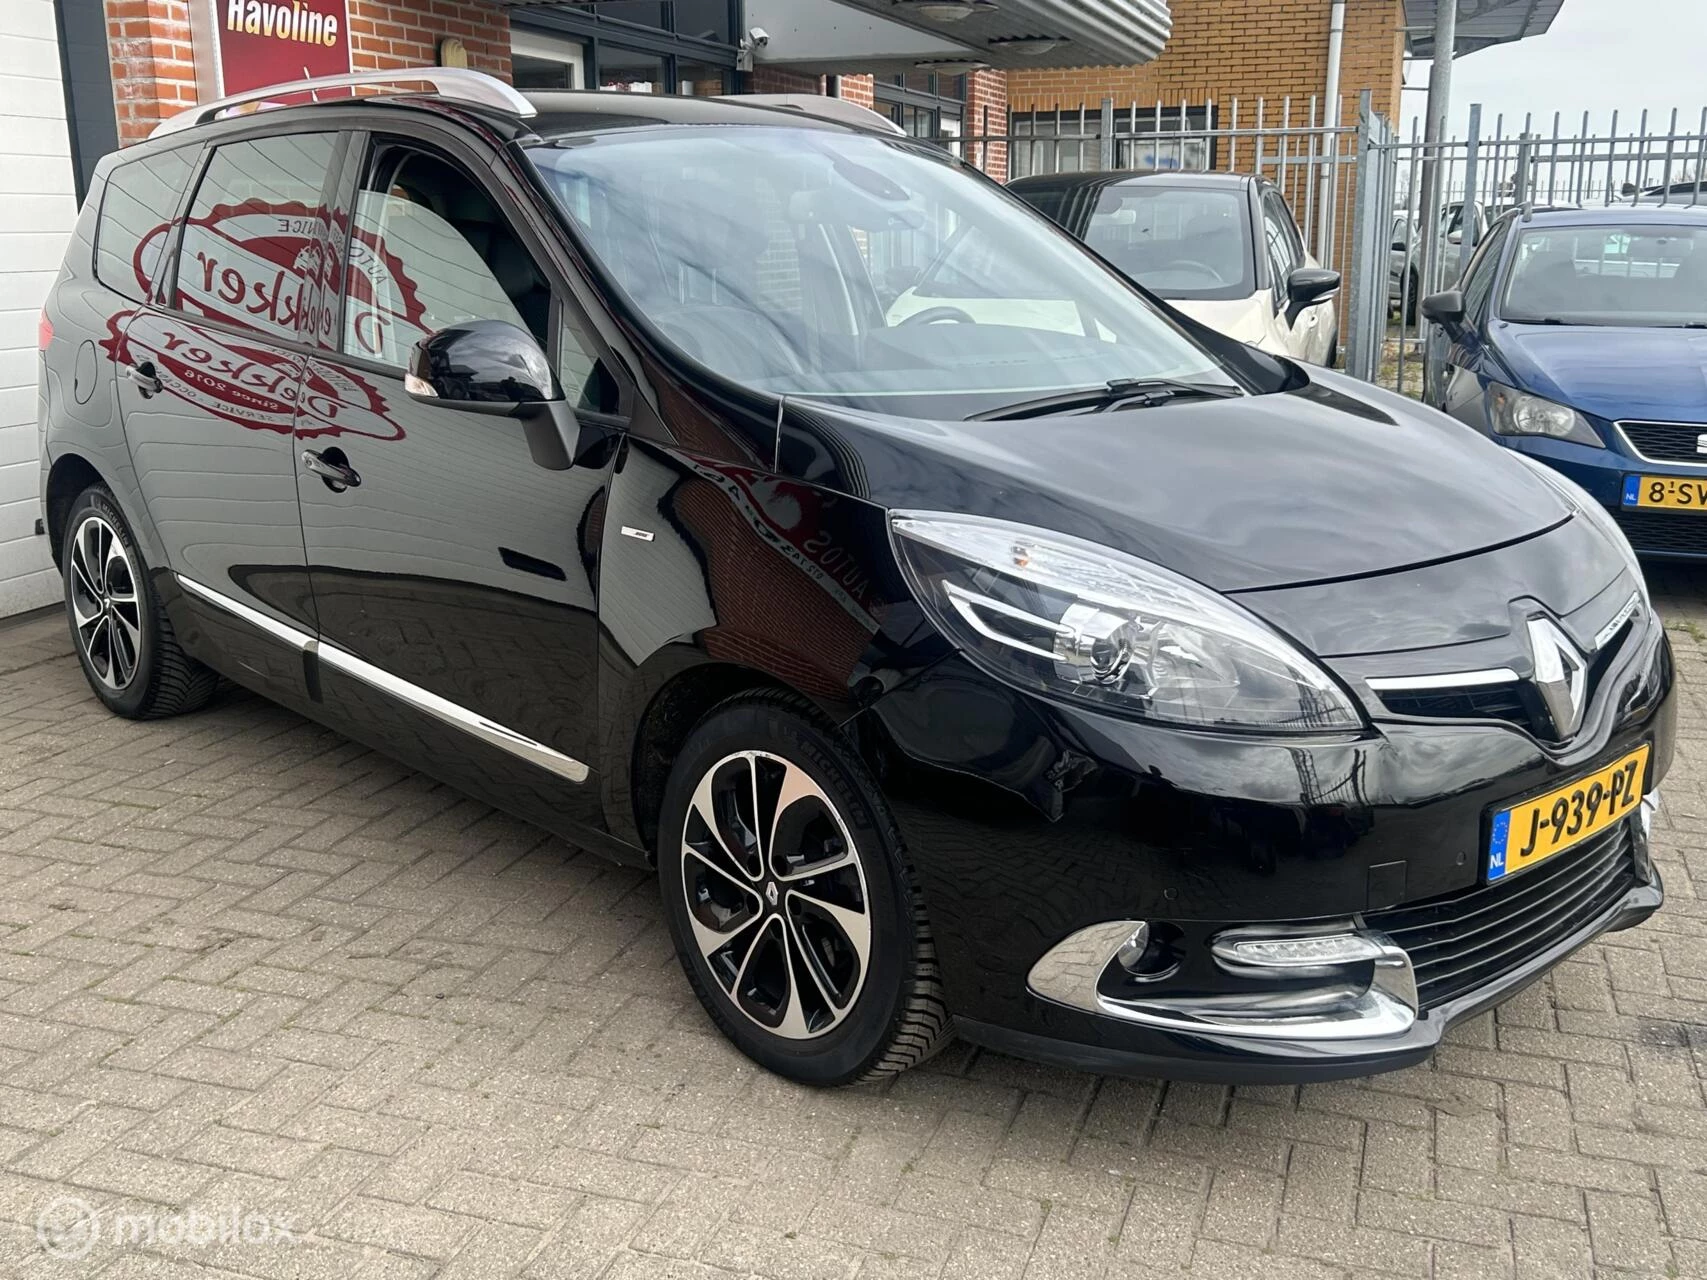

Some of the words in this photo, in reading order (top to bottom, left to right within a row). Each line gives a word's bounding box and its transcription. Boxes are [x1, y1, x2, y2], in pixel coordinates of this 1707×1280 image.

[227, 0, 338, 47] Havoline
[1625, 493, 1637, 501] NL
[1520, 760, 1639, 857] J-939-PZ
[1489, 852, 1504, 869] NL
